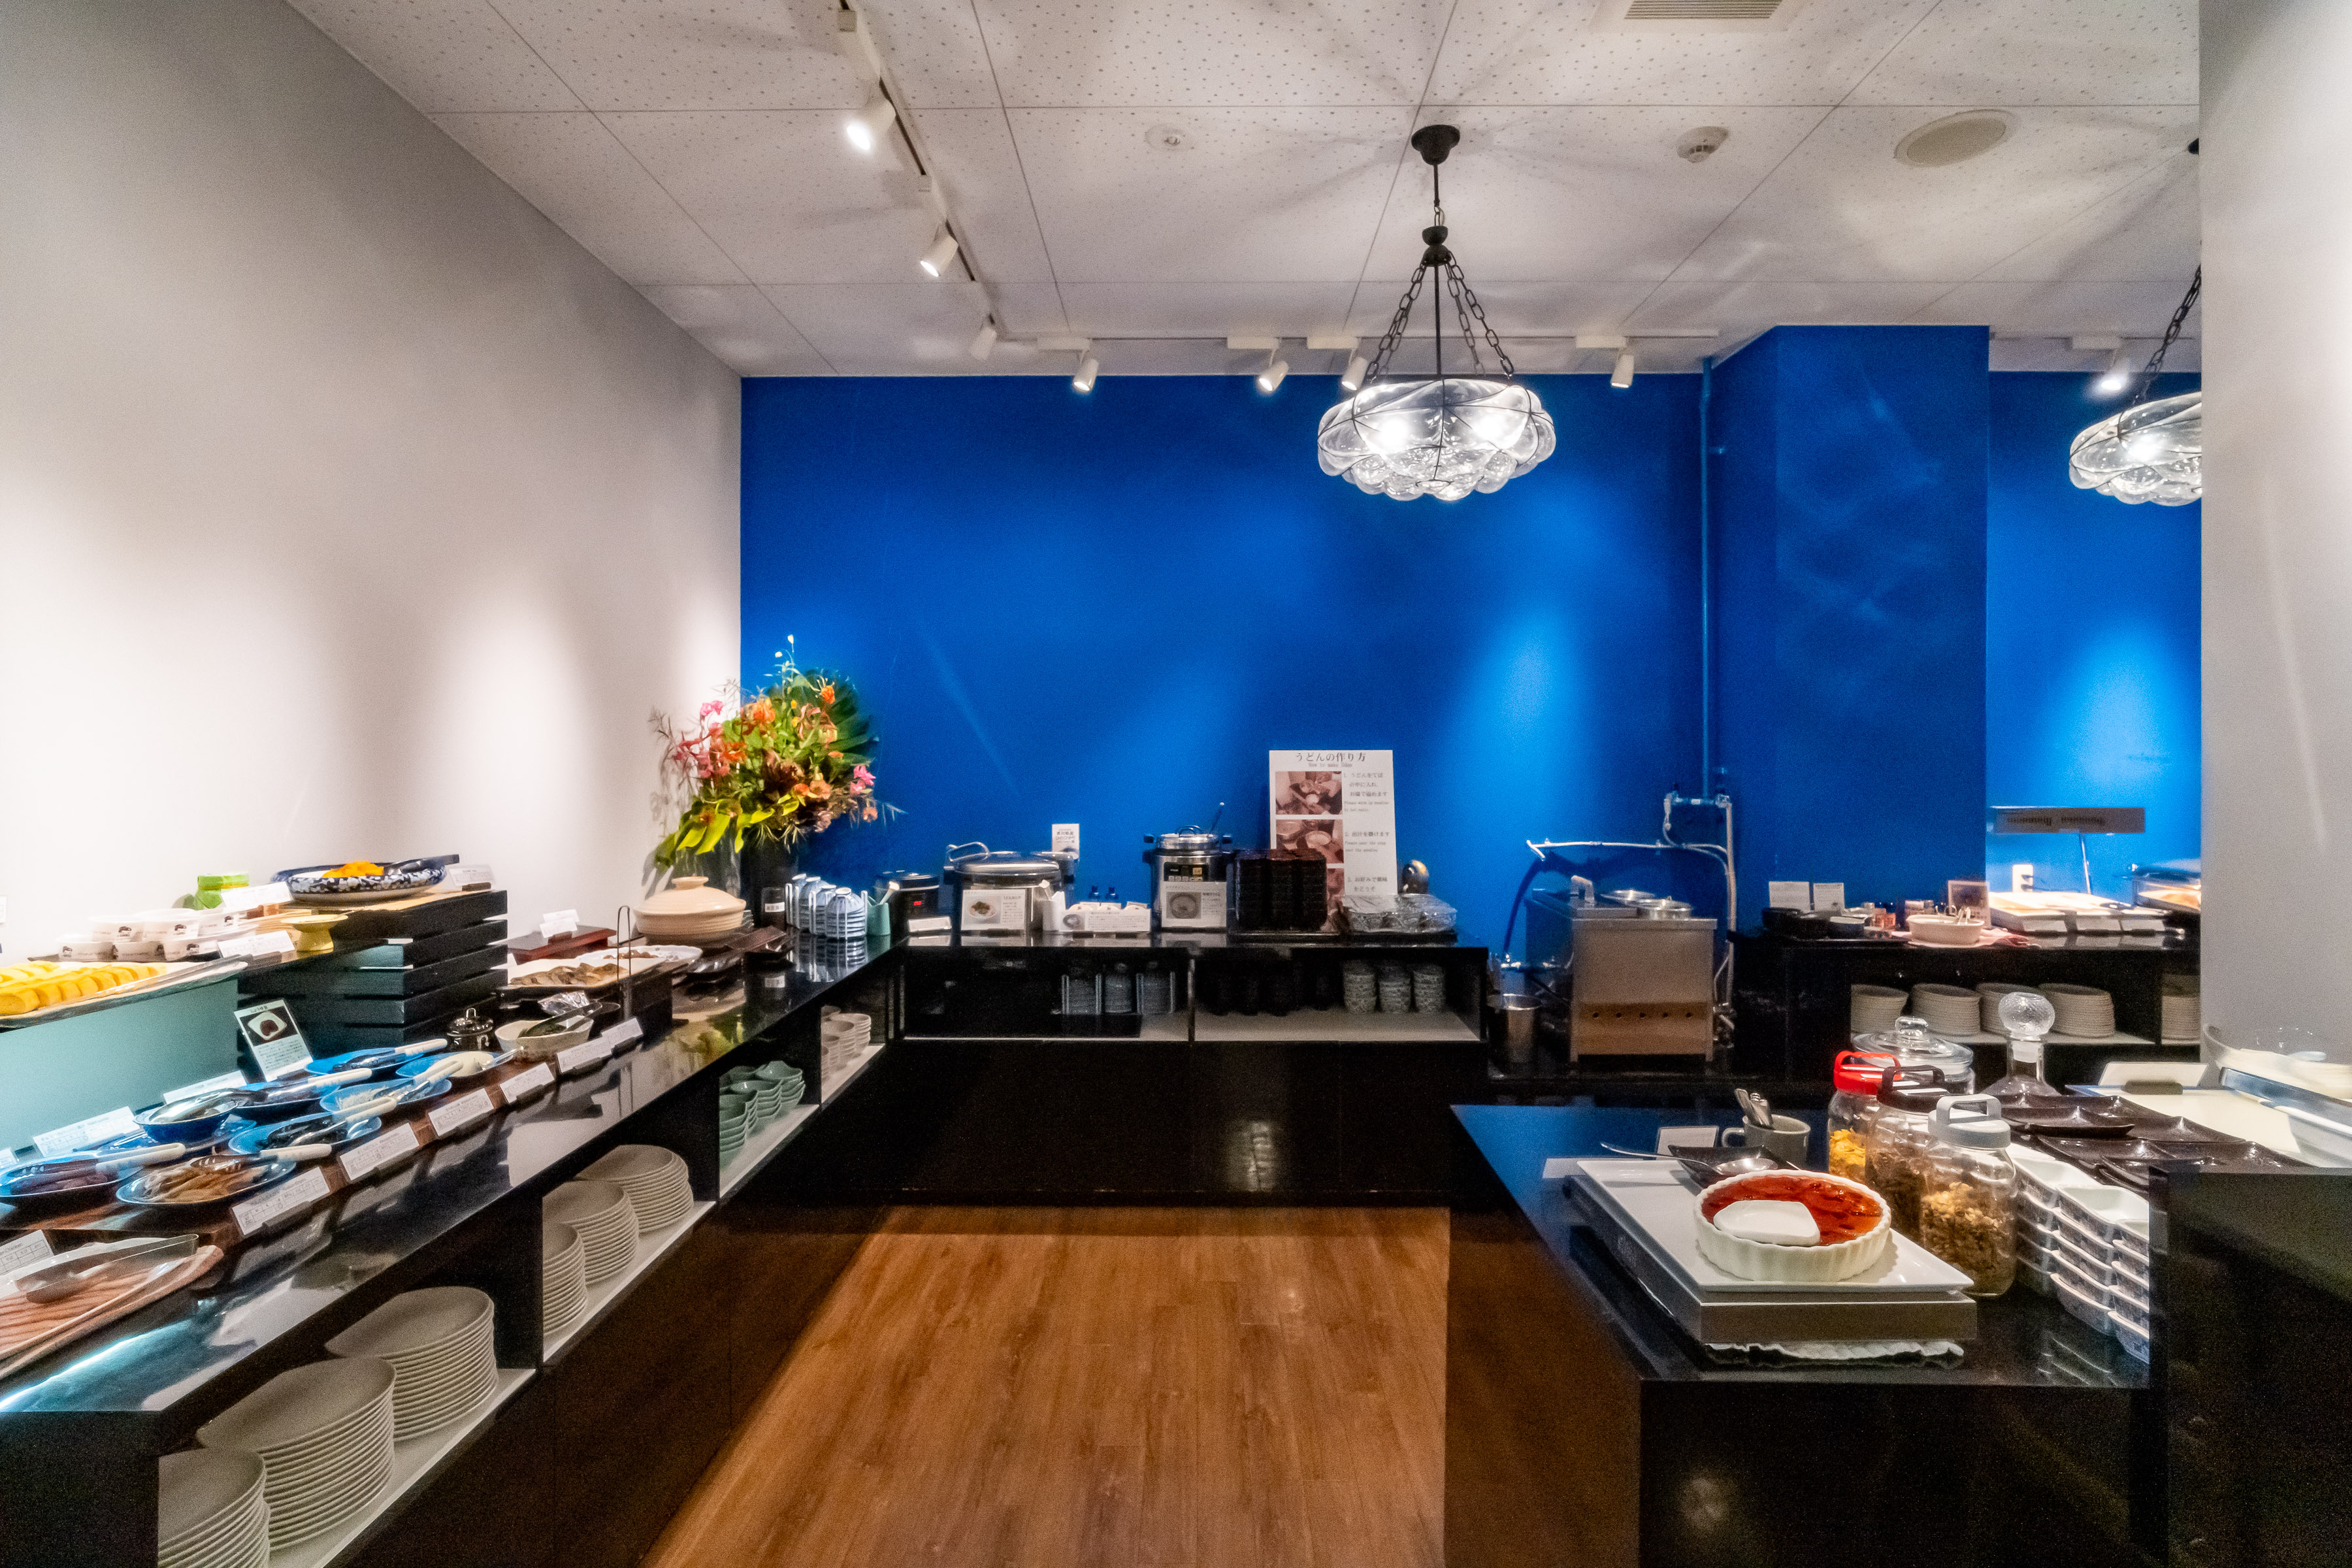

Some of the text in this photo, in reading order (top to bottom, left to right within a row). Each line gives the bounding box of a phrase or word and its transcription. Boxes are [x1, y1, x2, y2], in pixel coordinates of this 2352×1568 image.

[1296, 752, 1366, 762] うどんの作り方
